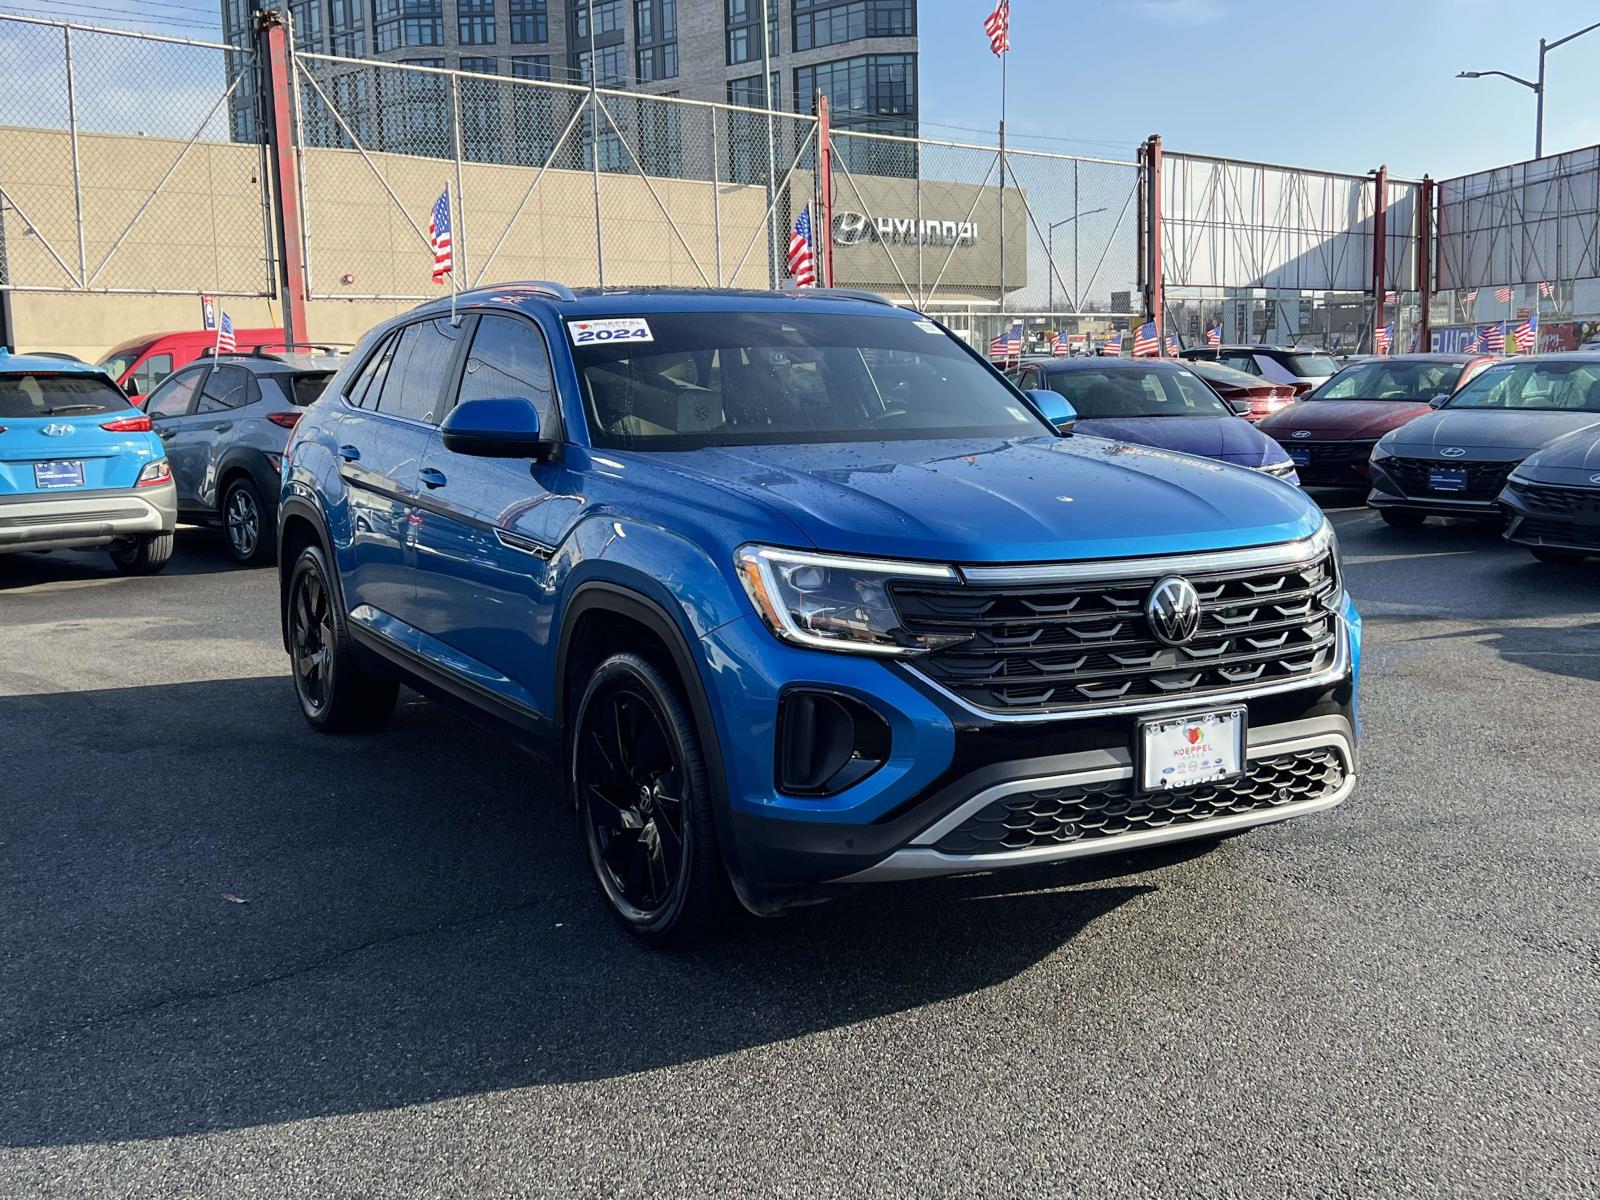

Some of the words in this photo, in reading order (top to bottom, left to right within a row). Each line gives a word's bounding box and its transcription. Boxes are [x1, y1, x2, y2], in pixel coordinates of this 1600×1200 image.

[877, 216, 978, 241] HYUNDAI
[577, 329, 648, 342] 2024
[1173, 744, 1213, 757] KOEPPEL
